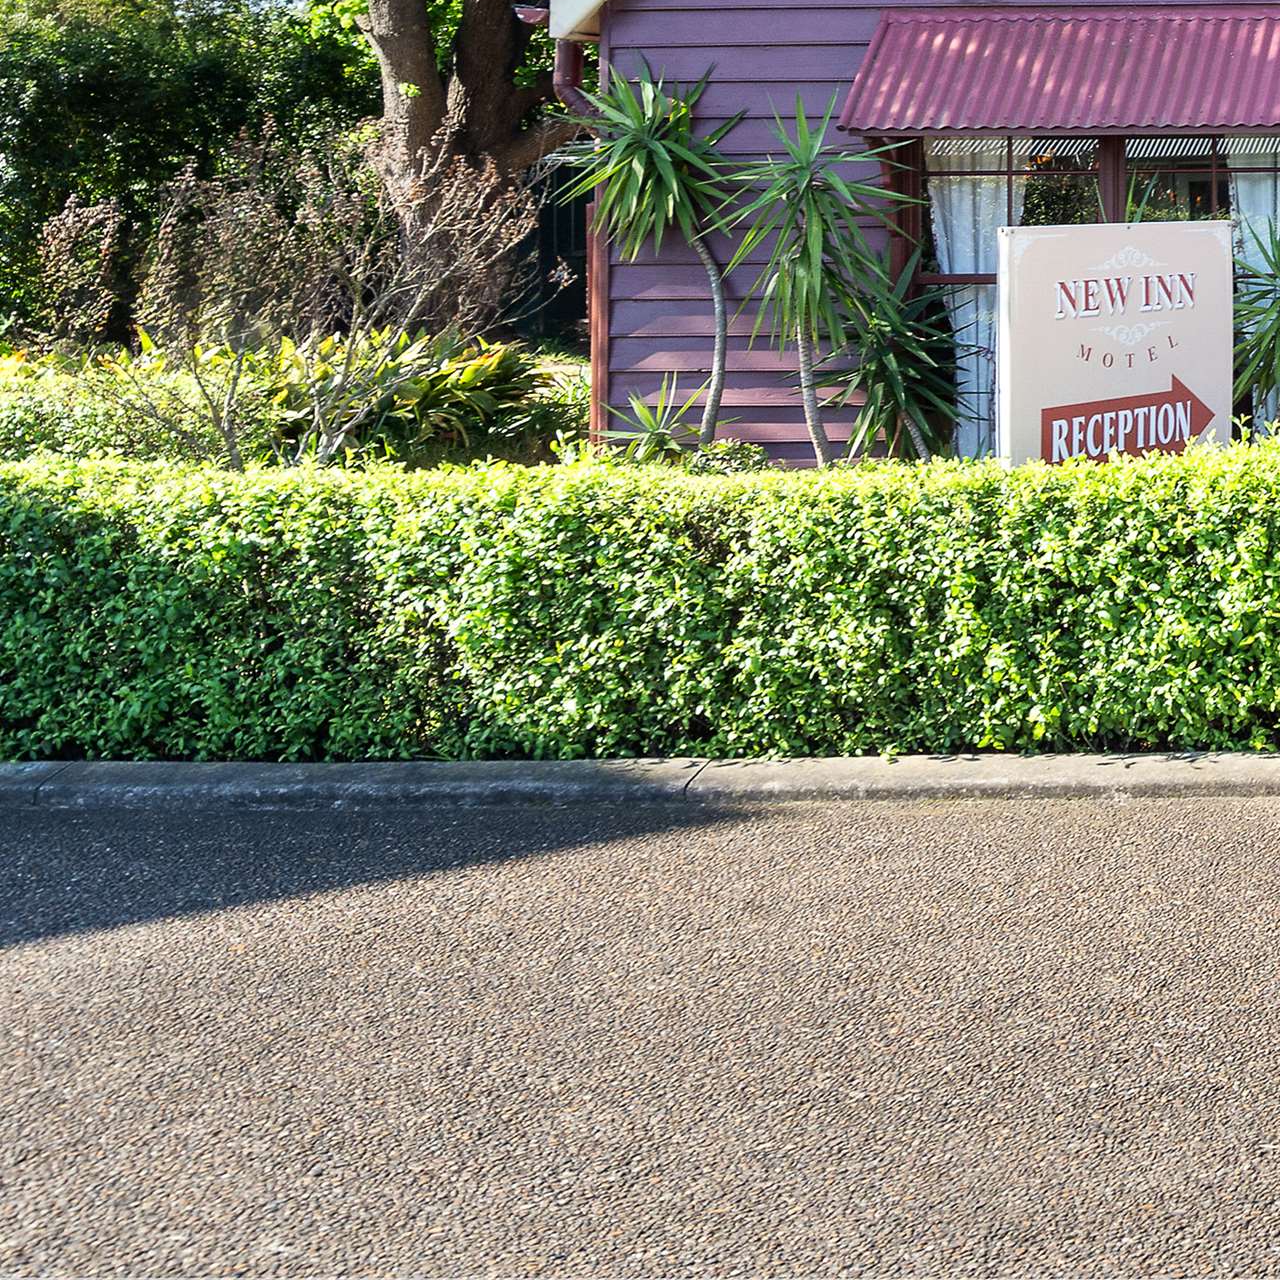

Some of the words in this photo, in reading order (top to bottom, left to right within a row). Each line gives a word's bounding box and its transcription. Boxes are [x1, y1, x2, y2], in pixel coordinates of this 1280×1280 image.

[1055, 276, 1132, 320] NEW
[1139, 272, 1198, 312] INN
[1076, 335, 1179, 368] MOTEL
[1051, 400, 1192, 463] RECEPTION
